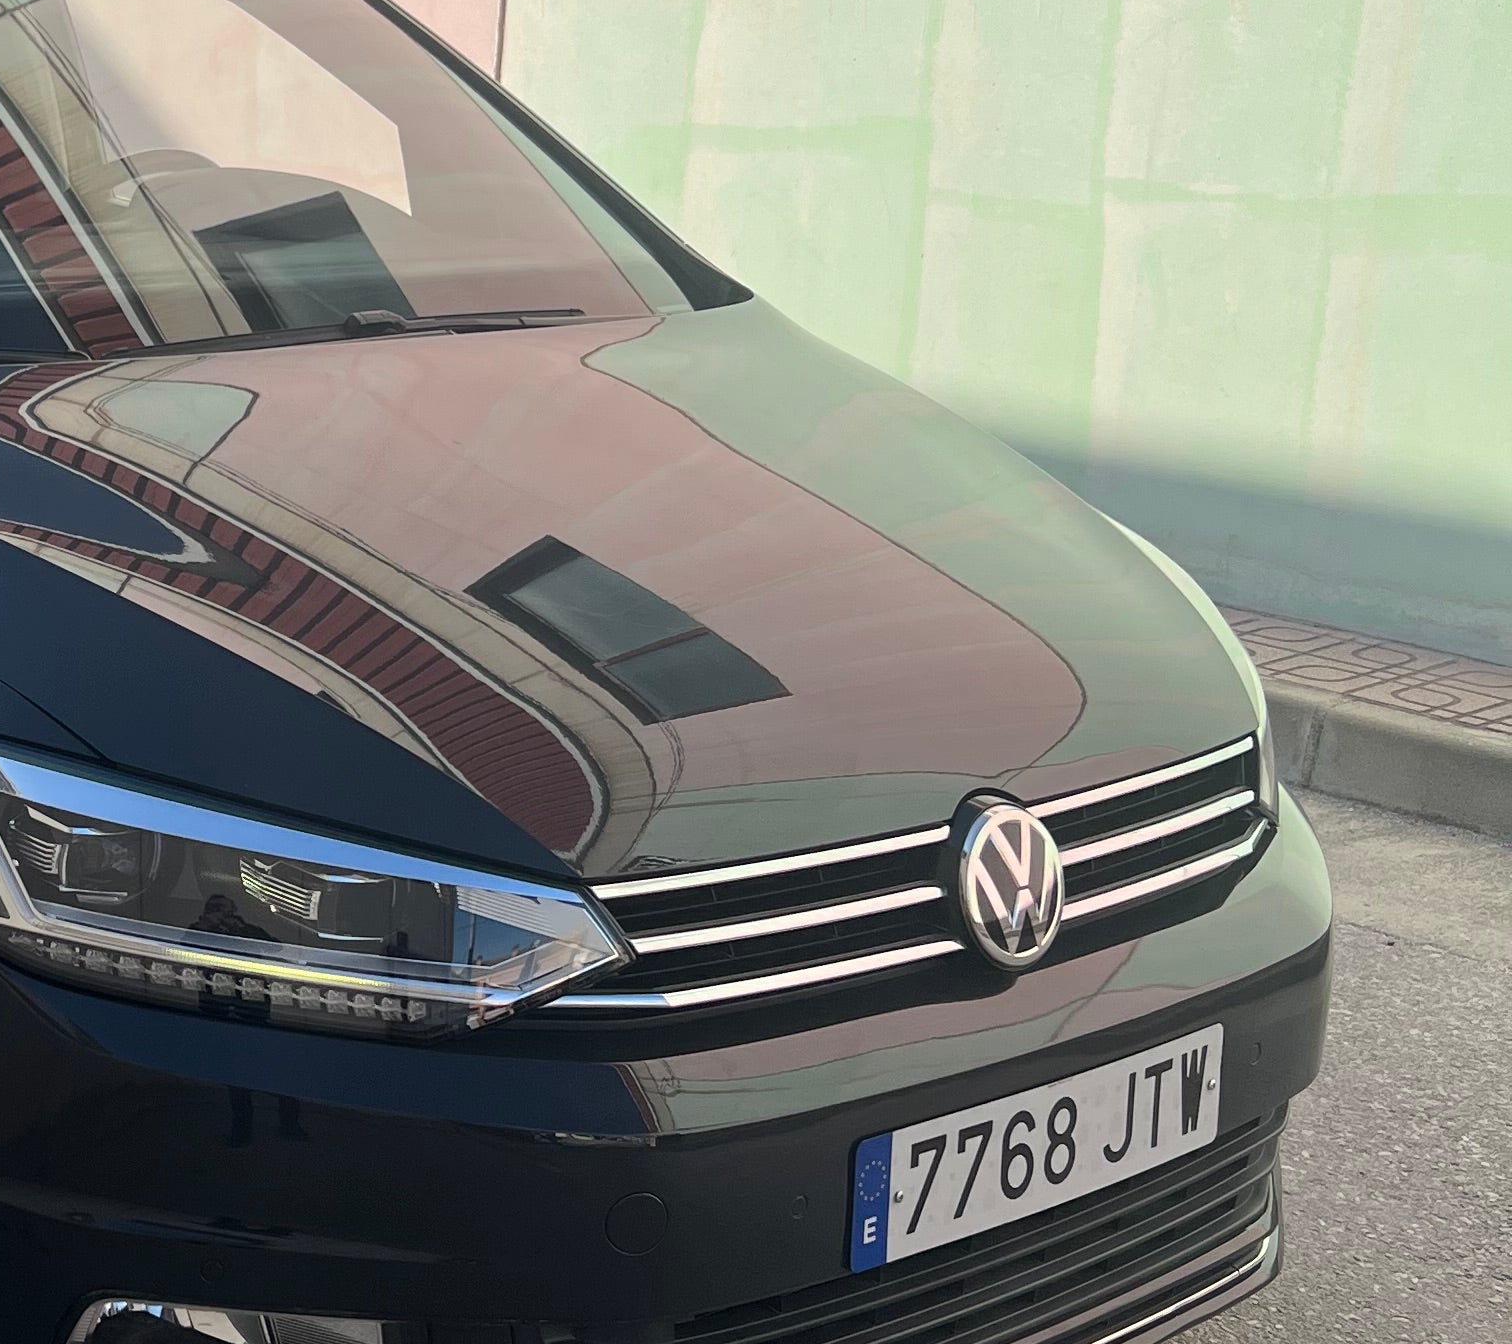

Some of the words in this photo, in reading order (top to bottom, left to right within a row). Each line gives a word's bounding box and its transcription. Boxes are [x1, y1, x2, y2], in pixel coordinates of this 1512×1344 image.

[962, 802, 1064, 966] VW
[906, 1096, 1078, 1235] 7768
[1103, 1045, 1208, 1164] JTW
[863, 1216, 877, 1245] E
